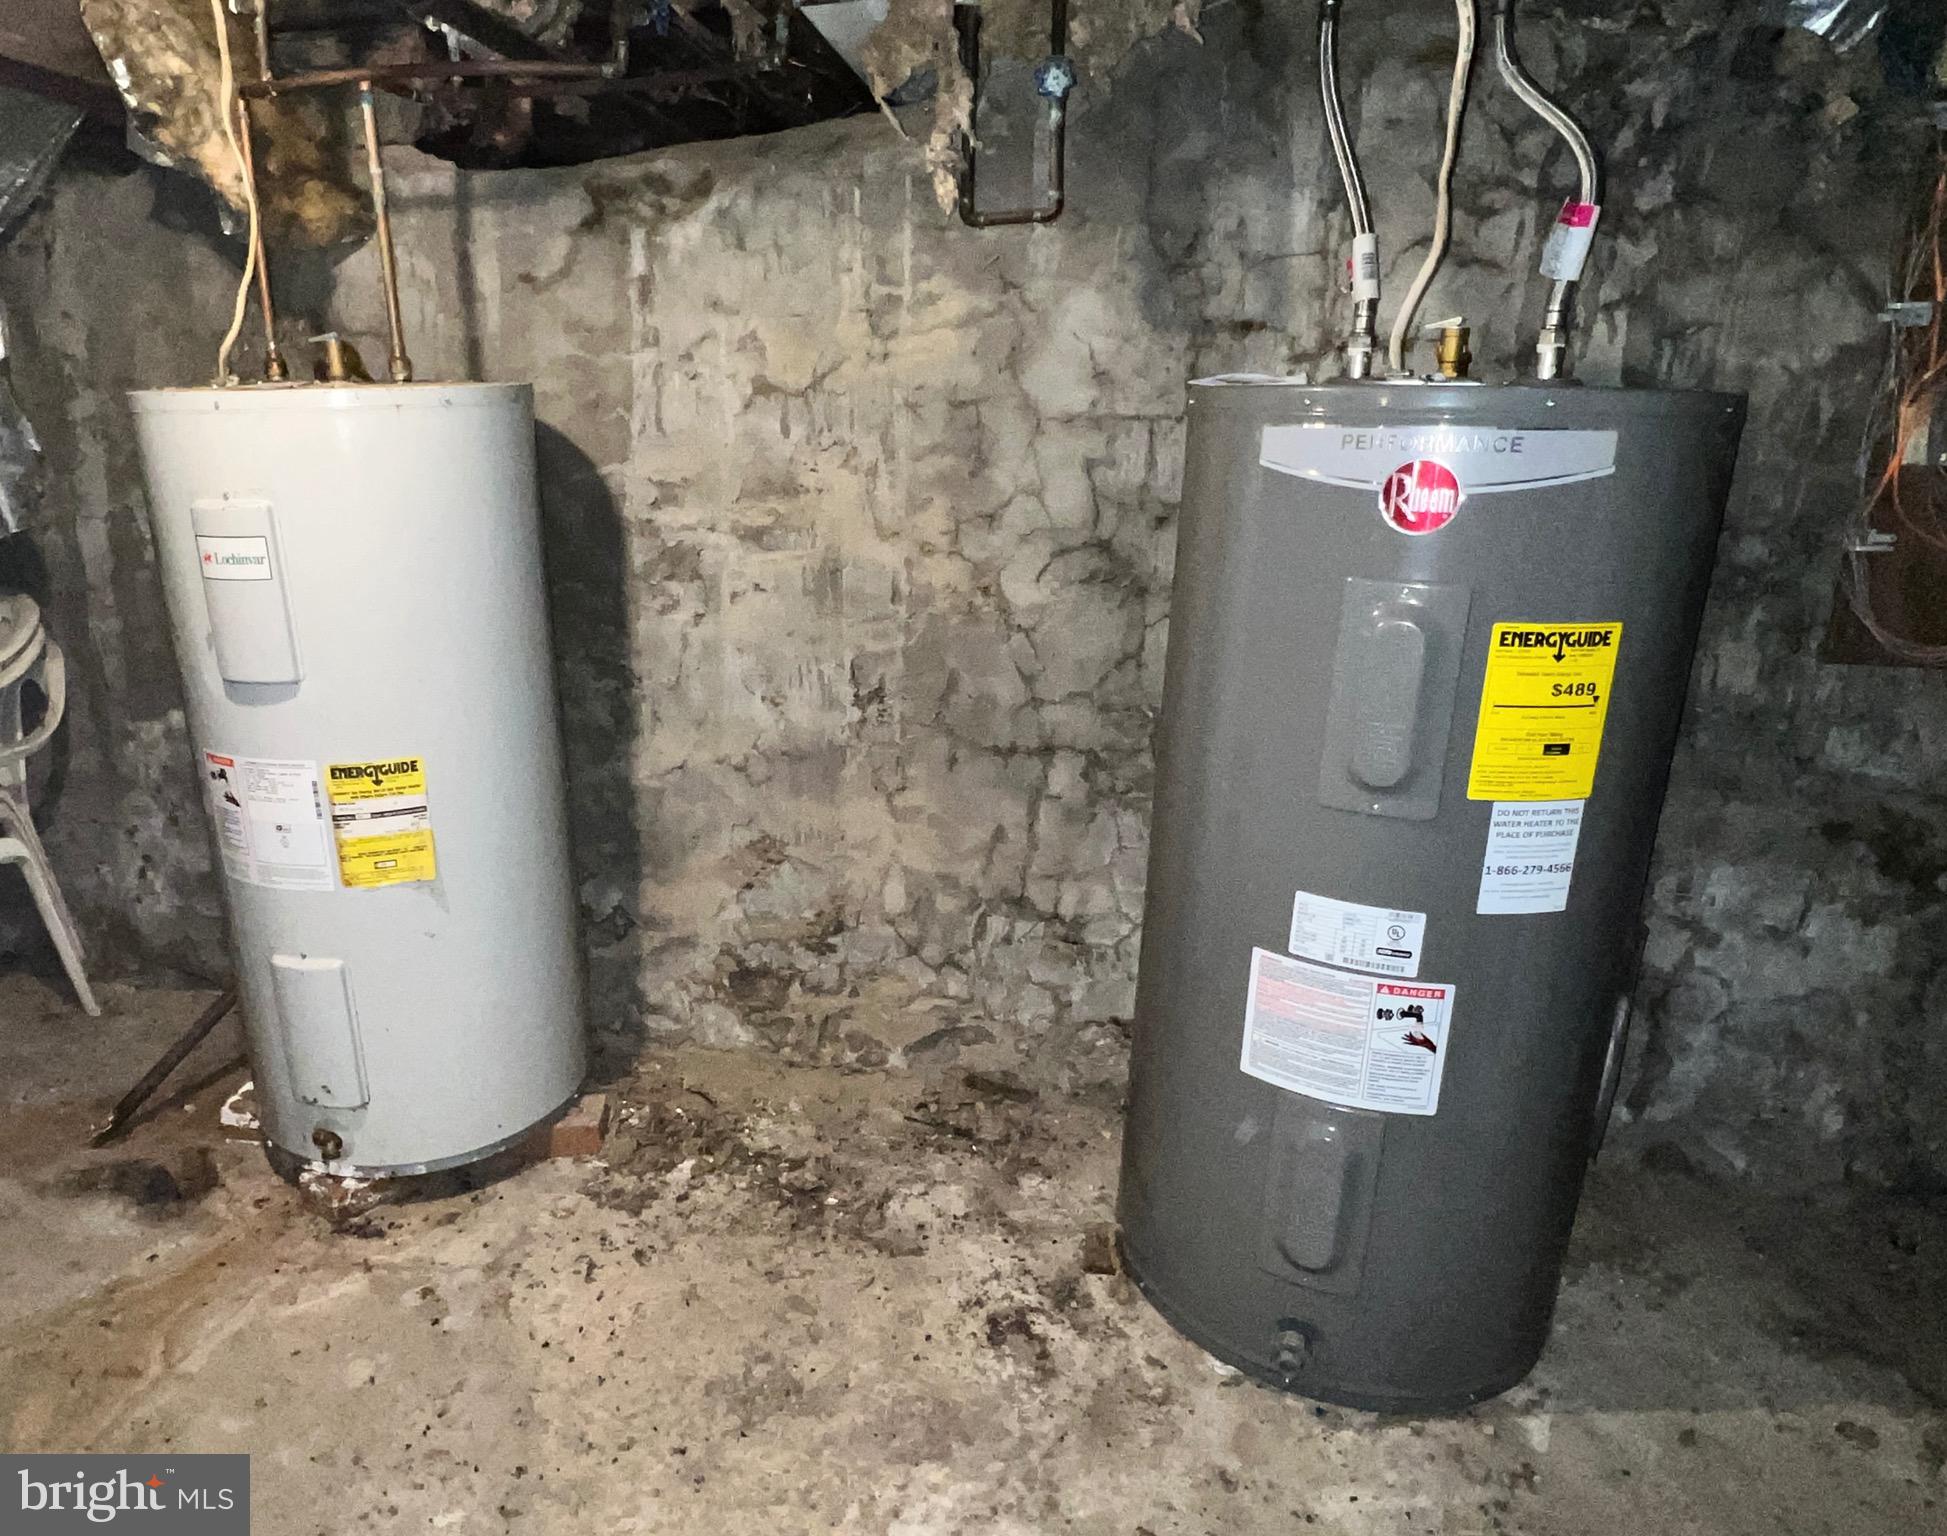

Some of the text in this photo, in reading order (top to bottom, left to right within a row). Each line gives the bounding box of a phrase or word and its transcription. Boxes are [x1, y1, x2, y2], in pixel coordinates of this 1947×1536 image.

[1341, 433, 1525, 453] PERFORMANCE
[1389, 461, 1456, 523] Rheem
[214, 552, 266, 566] Lochinvar
[1497, 809, 1510, 817] DO
[1512, 809, 1530, 817] NOT
[1531, 808, 1562, 816] RETURN
[1492, 820, 1521, 828] WATER
[1524, 819, 1553, 828] HEATER
[1495, 831, 1520, 839] PLACE
[1393, 987, 1443, 998] DANGER
